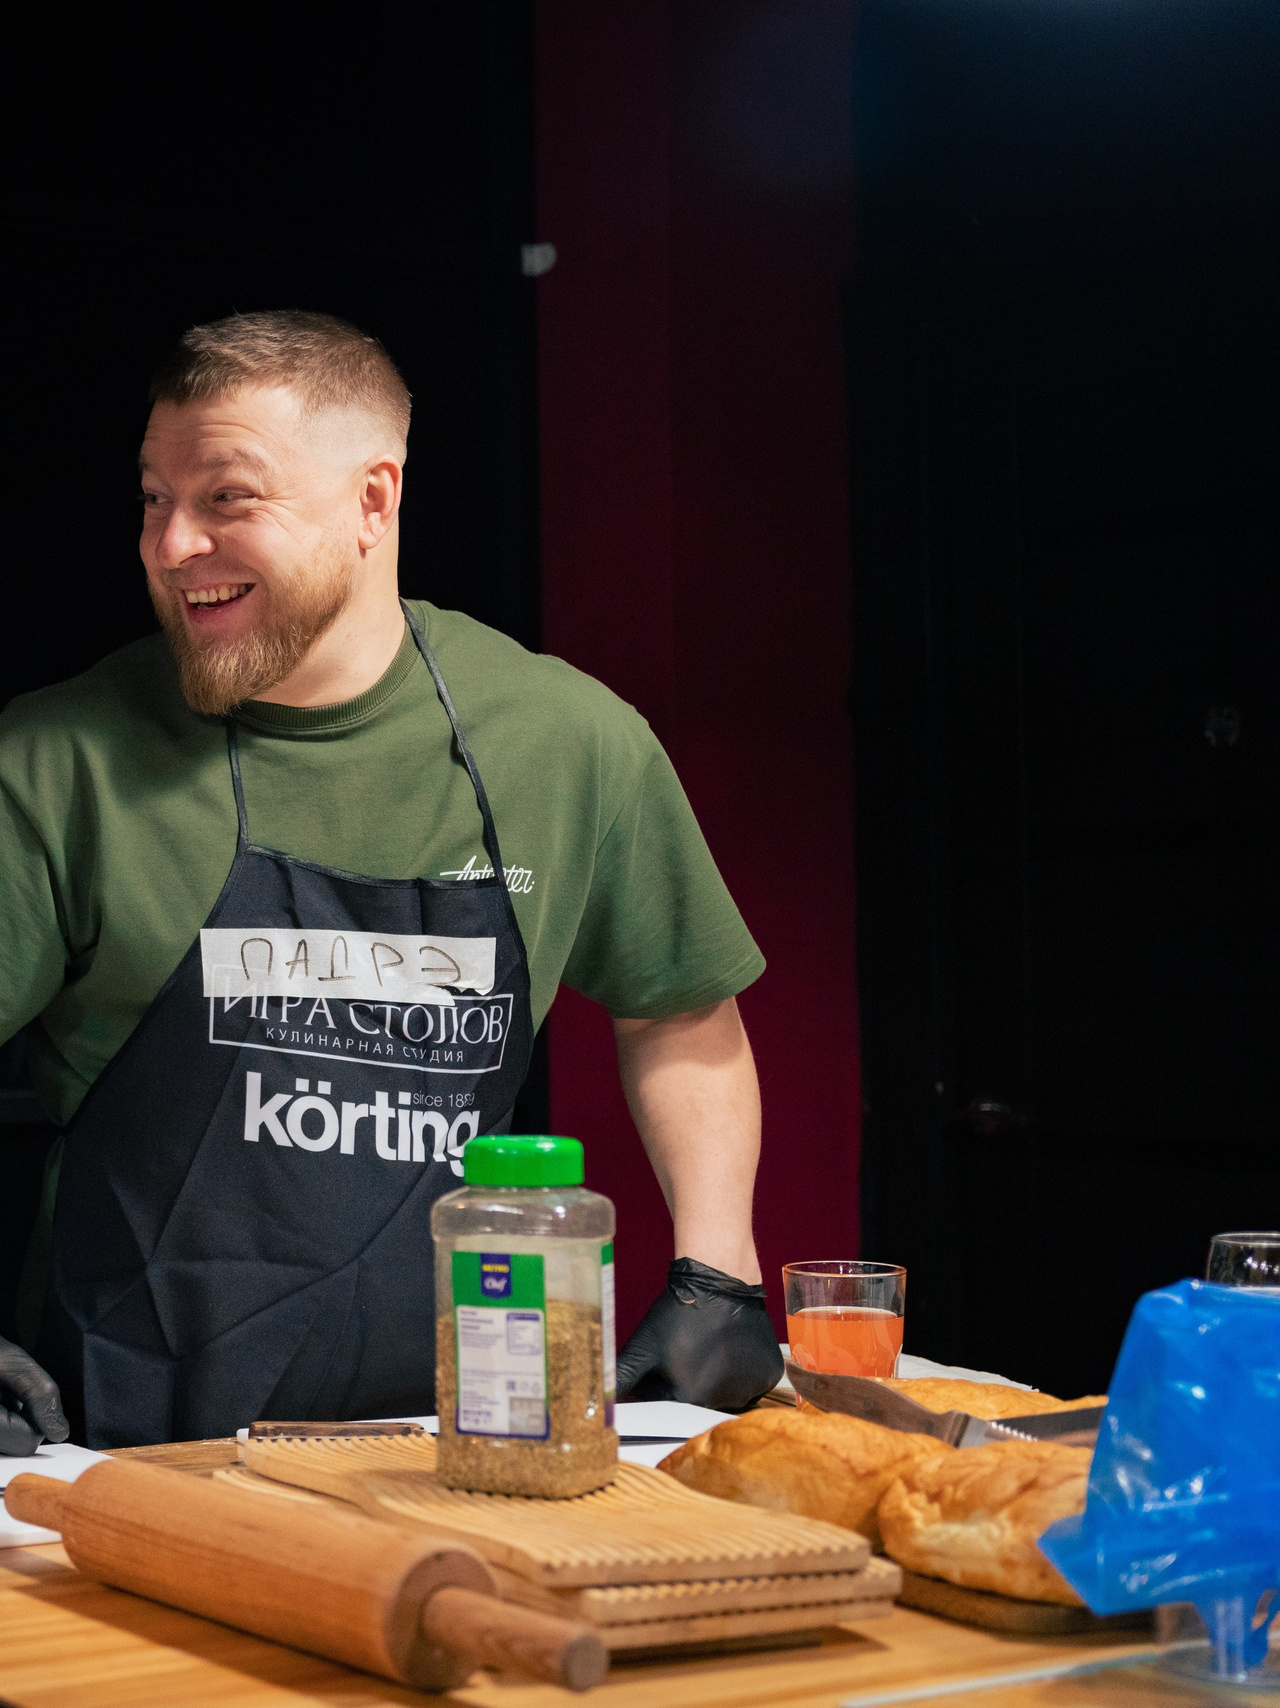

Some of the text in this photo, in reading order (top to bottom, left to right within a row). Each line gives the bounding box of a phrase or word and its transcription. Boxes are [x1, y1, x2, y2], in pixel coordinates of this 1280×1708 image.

[240, 935, 462, 987] ПАДРЭ
[265, 1027, 465, 1063] КУЛИНАРНАЯ СТУДИЯ
[349, 1003, 503, 1044] СТОЛОВ
[243, 1071, 481, 1177] körting
